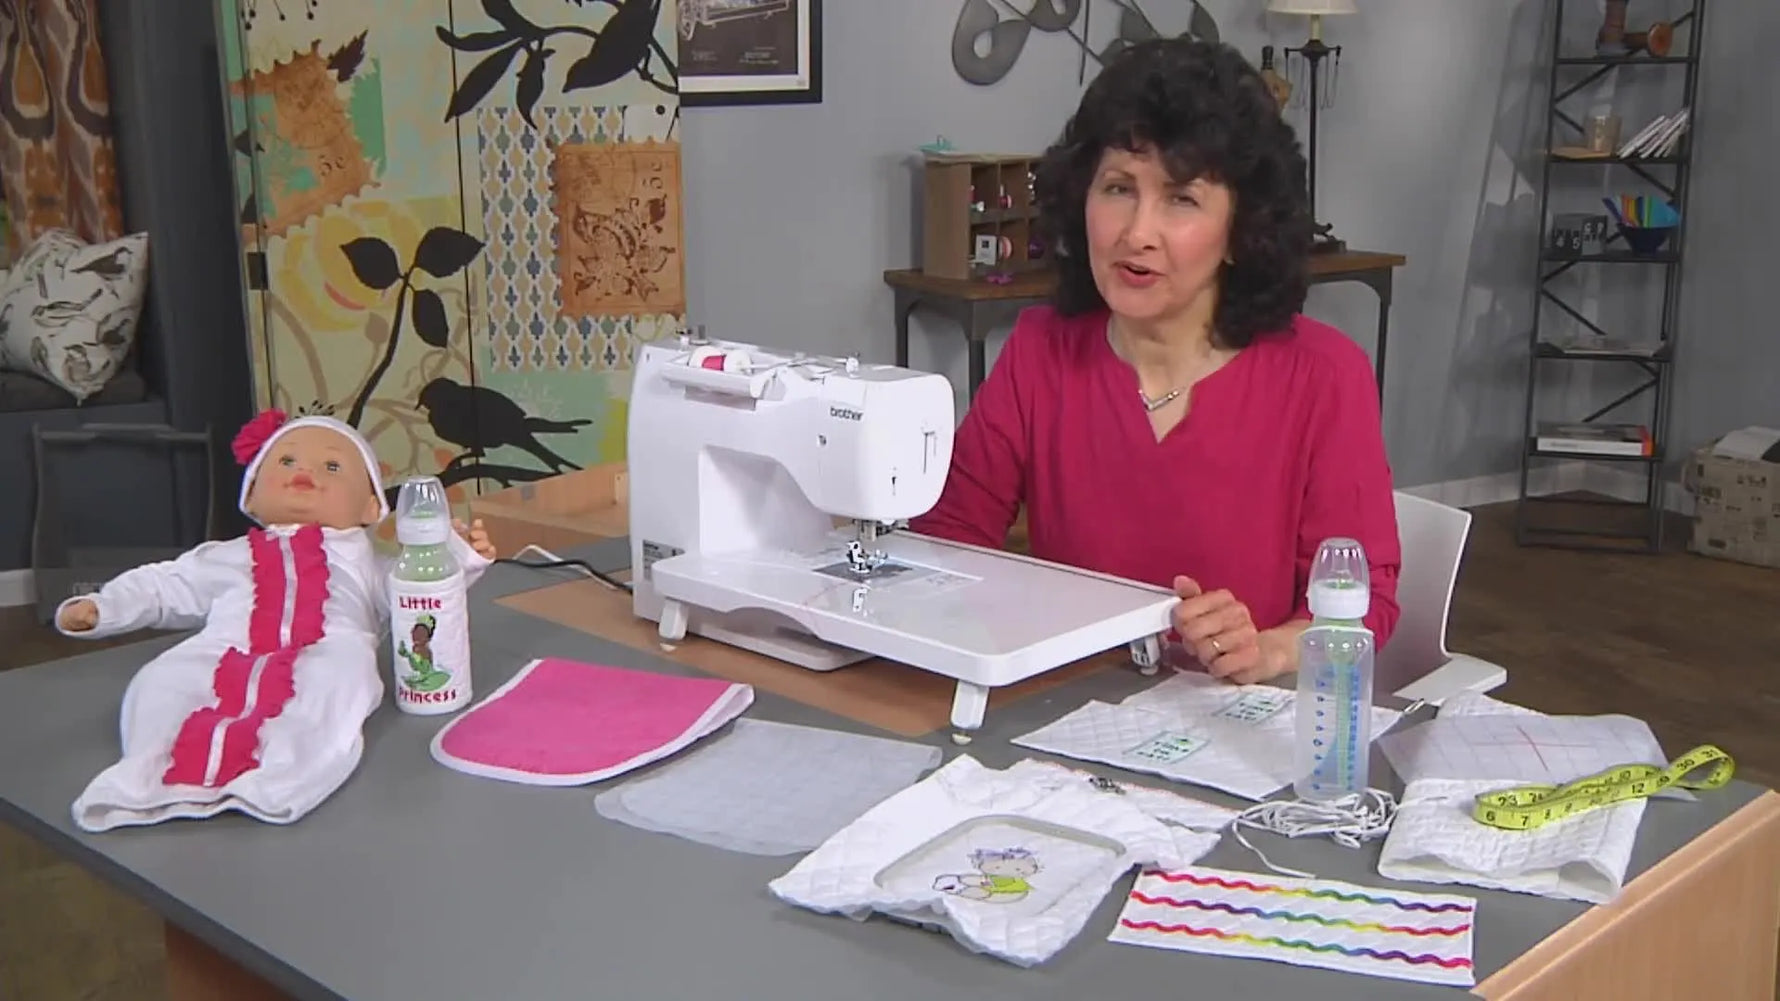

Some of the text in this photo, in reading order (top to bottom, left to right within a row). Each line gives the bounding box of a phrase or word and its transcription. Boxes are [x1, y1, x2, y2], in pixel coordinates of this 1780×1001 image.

[829, 405, 863, 421] brother
[399, 596, 442, 610] Little
[1676, 758, 1696, 771] 30
[1486, 810, 1496, 822] 6
[1520, 815, 1530, 827] 7
[1631, 782, 1645, 794] 12
[1498, 794, 1518, 807] 23
